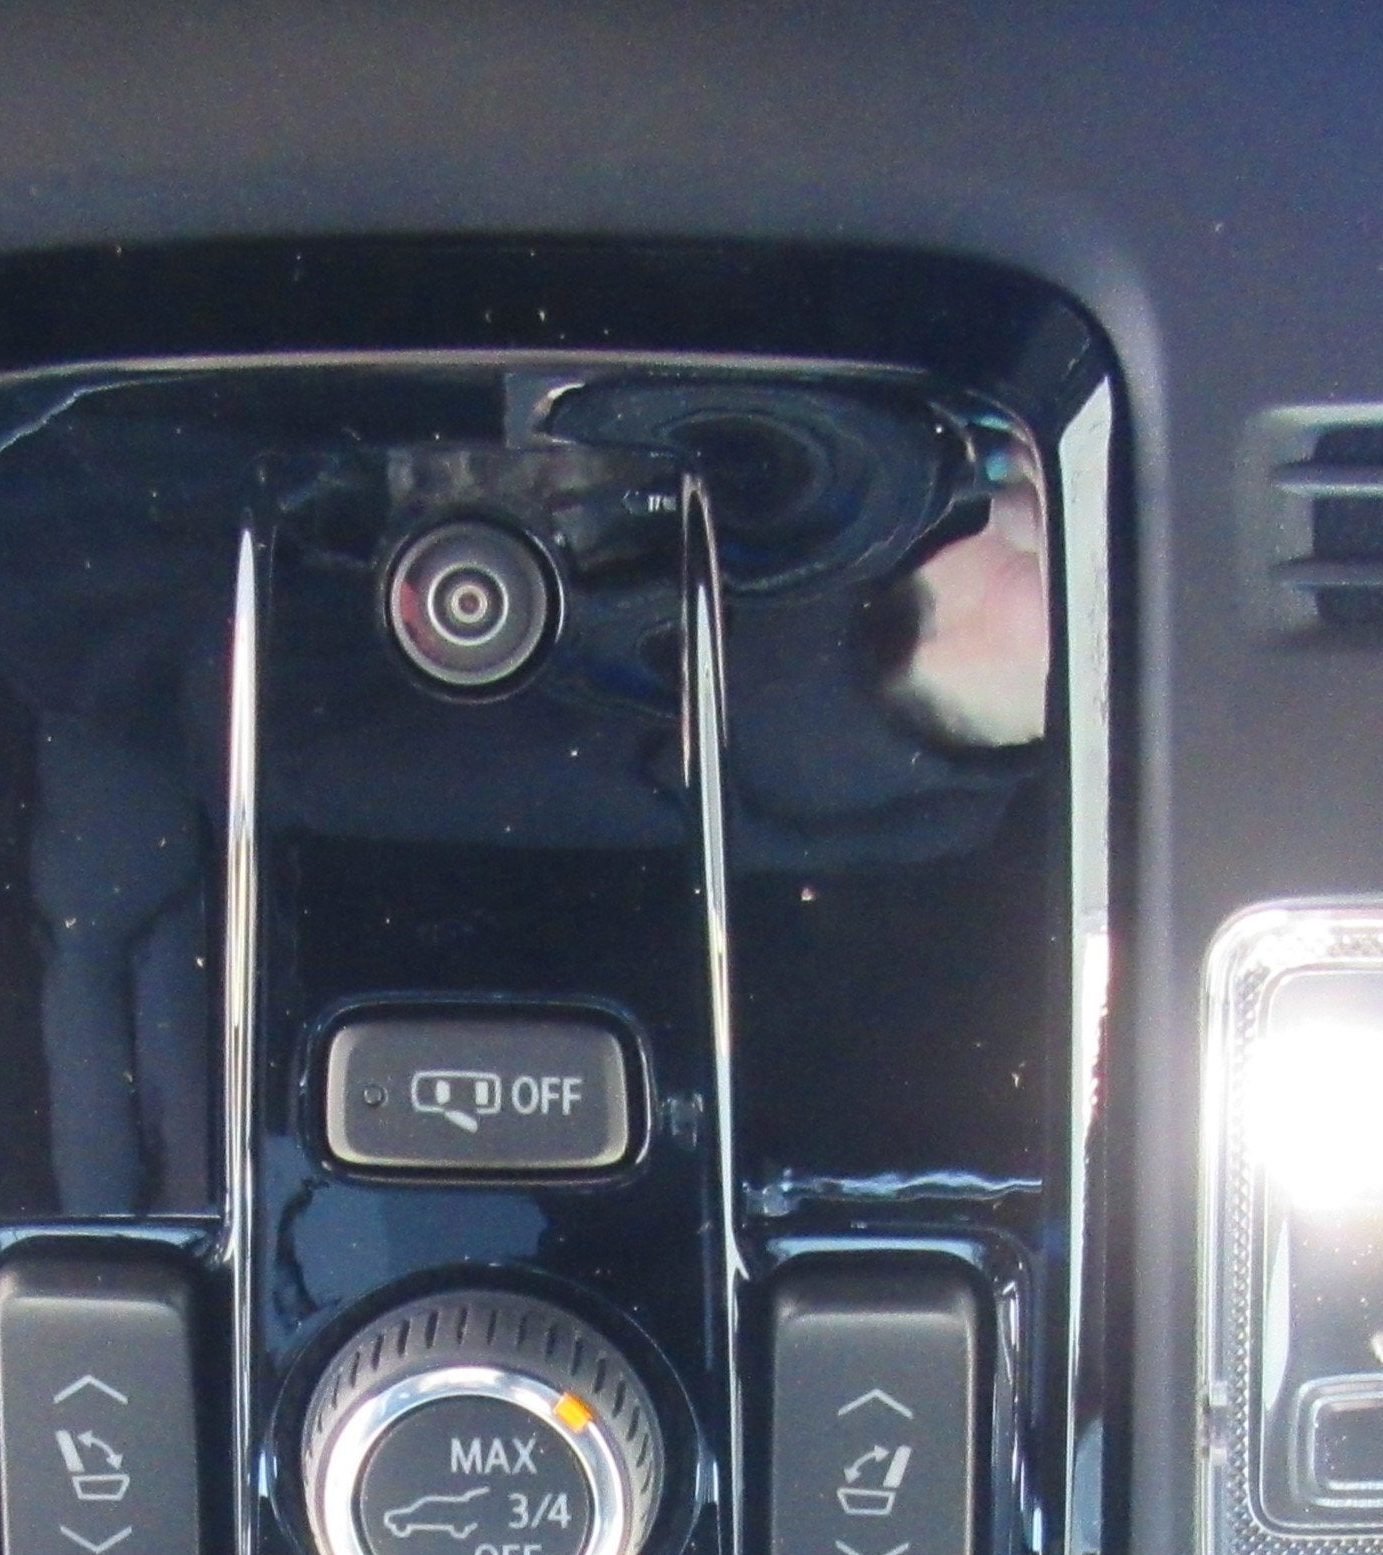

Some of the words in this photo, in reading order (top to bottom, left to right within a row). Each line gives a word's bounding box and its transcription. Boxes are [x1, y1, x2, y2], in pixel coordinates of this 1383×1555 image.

[511, 1075, 583, 1116] OFF
[450, 1437, 537, 1475] MAX
[507, 1492, 572, 1529] 3/4
